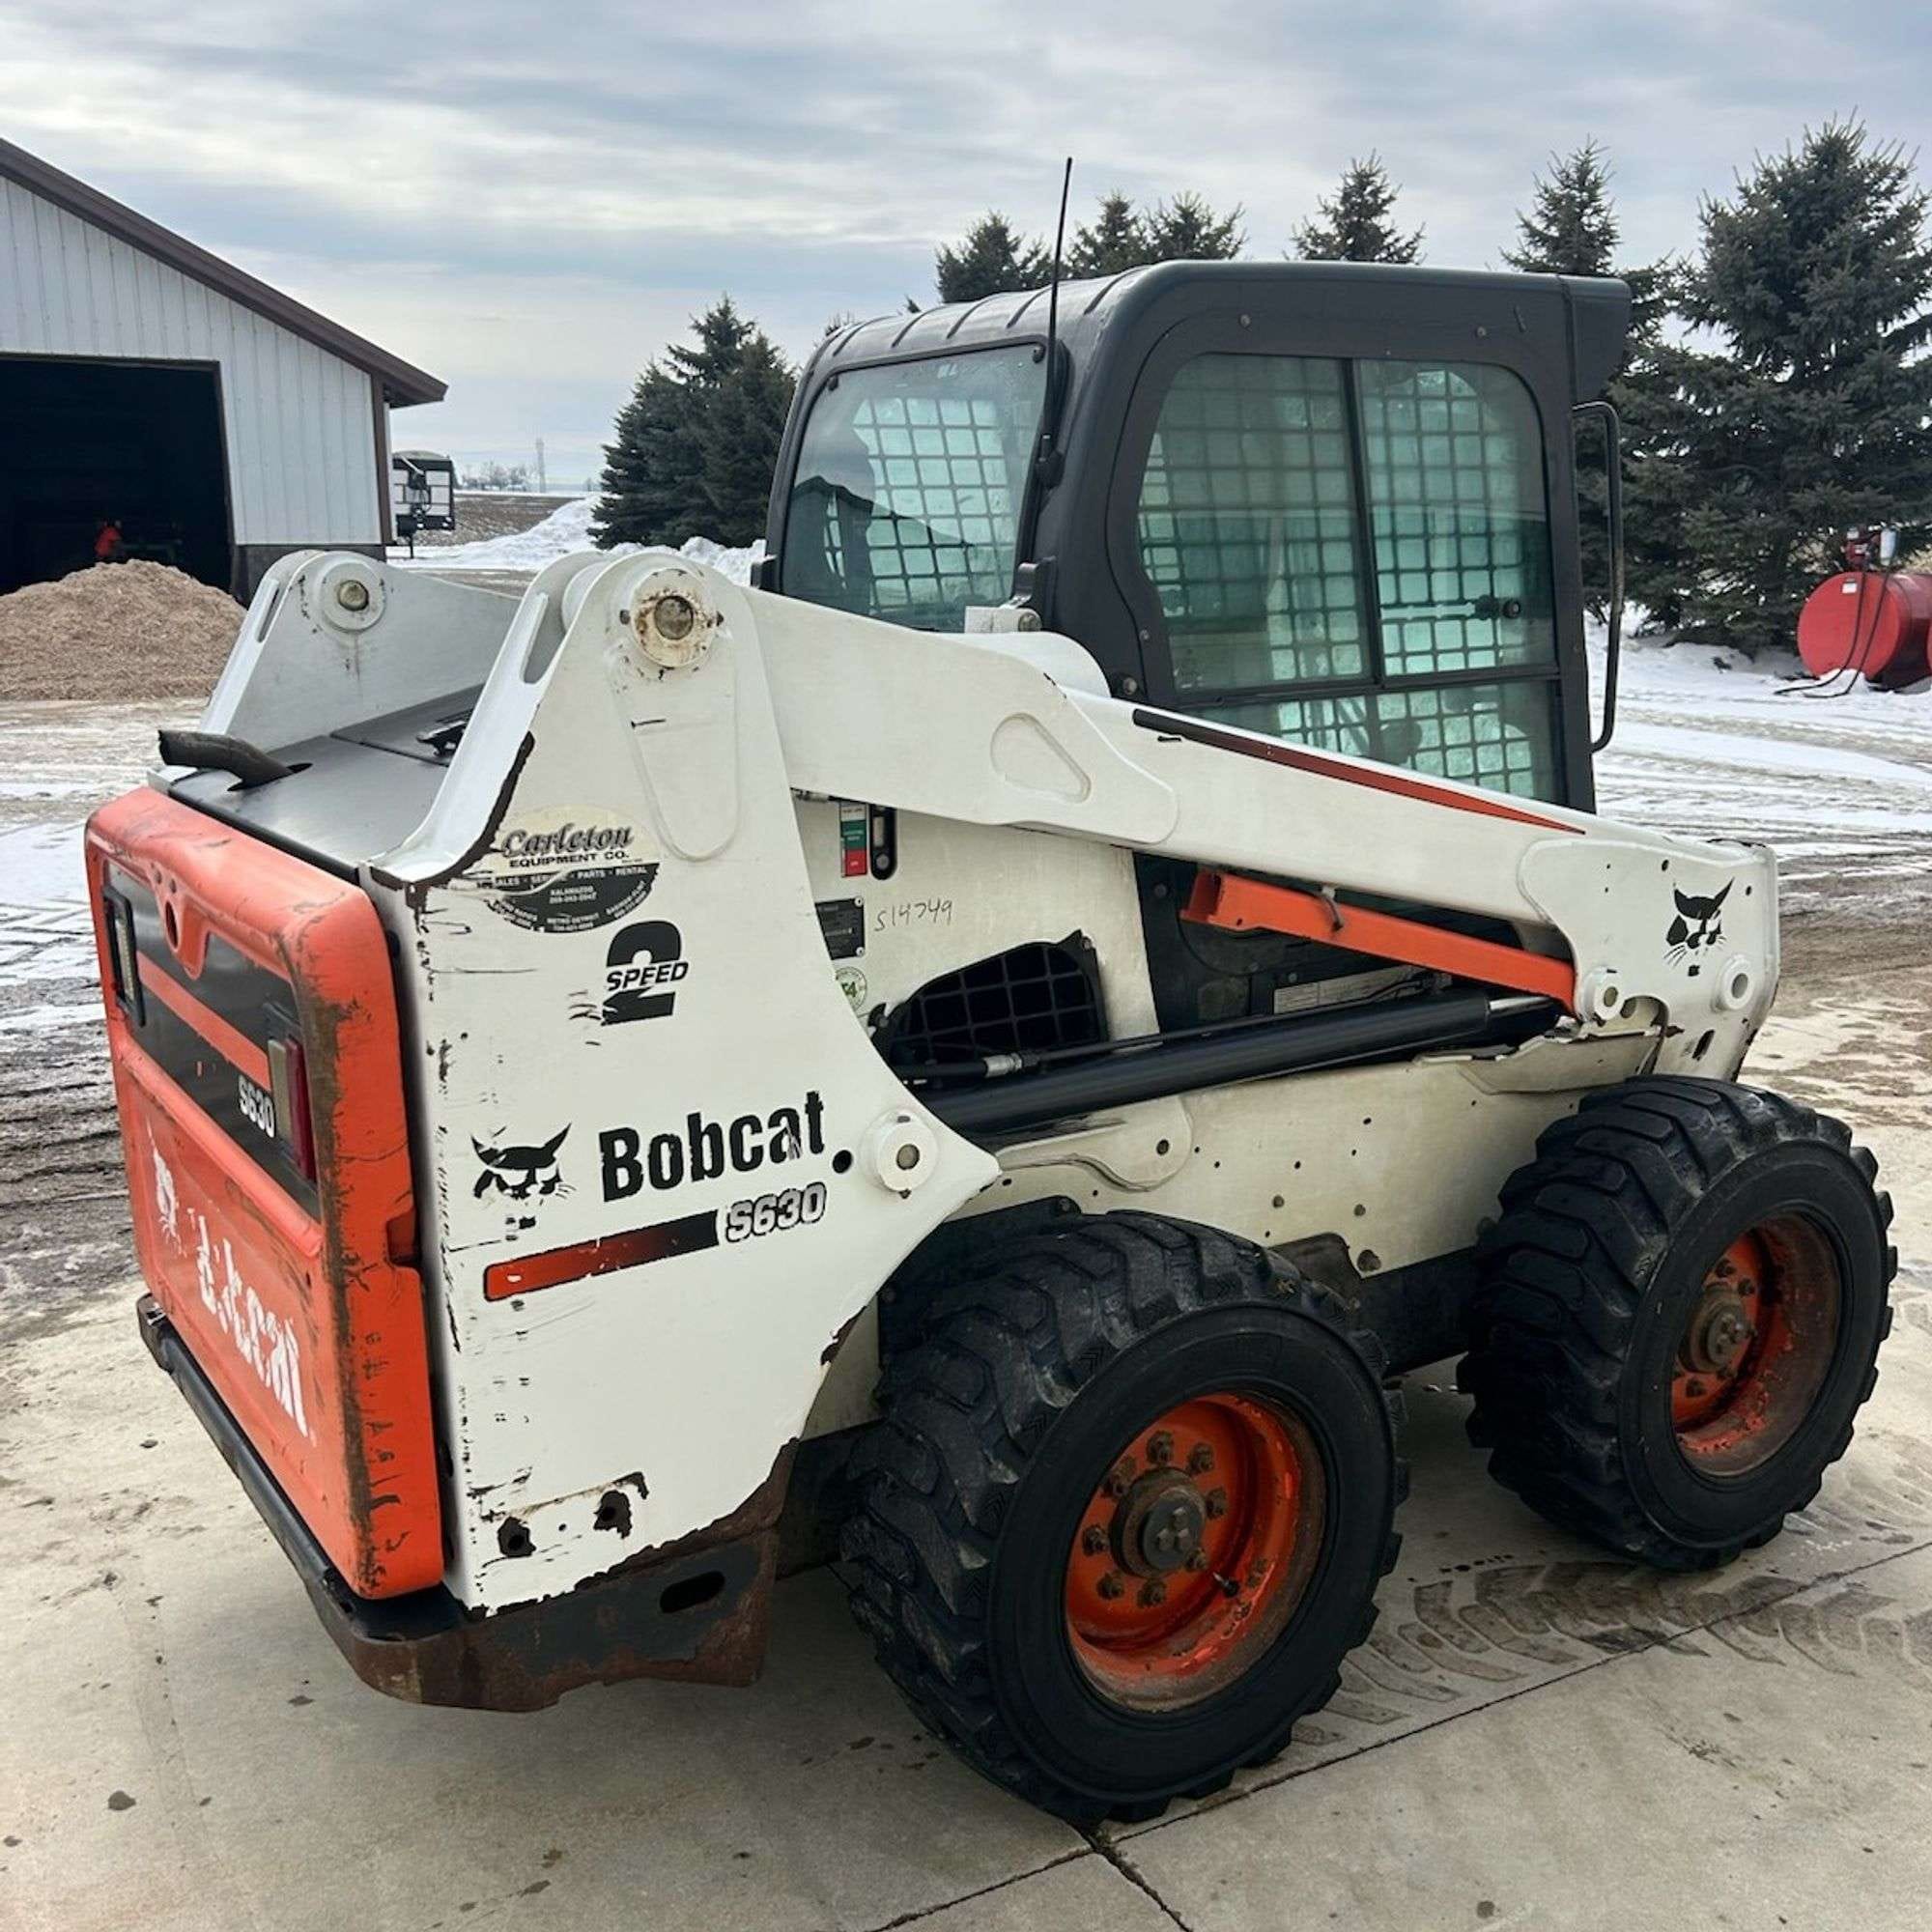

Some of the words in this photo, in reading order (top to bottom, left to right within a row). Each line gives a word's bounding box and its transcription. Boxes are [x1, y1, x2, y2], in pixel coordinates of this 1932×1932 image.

[501, 823, 635, 858] Carleton
[509, 853, 597, 867] EQUIPMENT
[605, 851, 630, 861] CO.
[607, 961, 689, 991] SPEED
[238, 1074, 275, 1138] S630
[598, 1091, 825, 1203] Bobcat
[724, 1181, 828, 1243] S630
